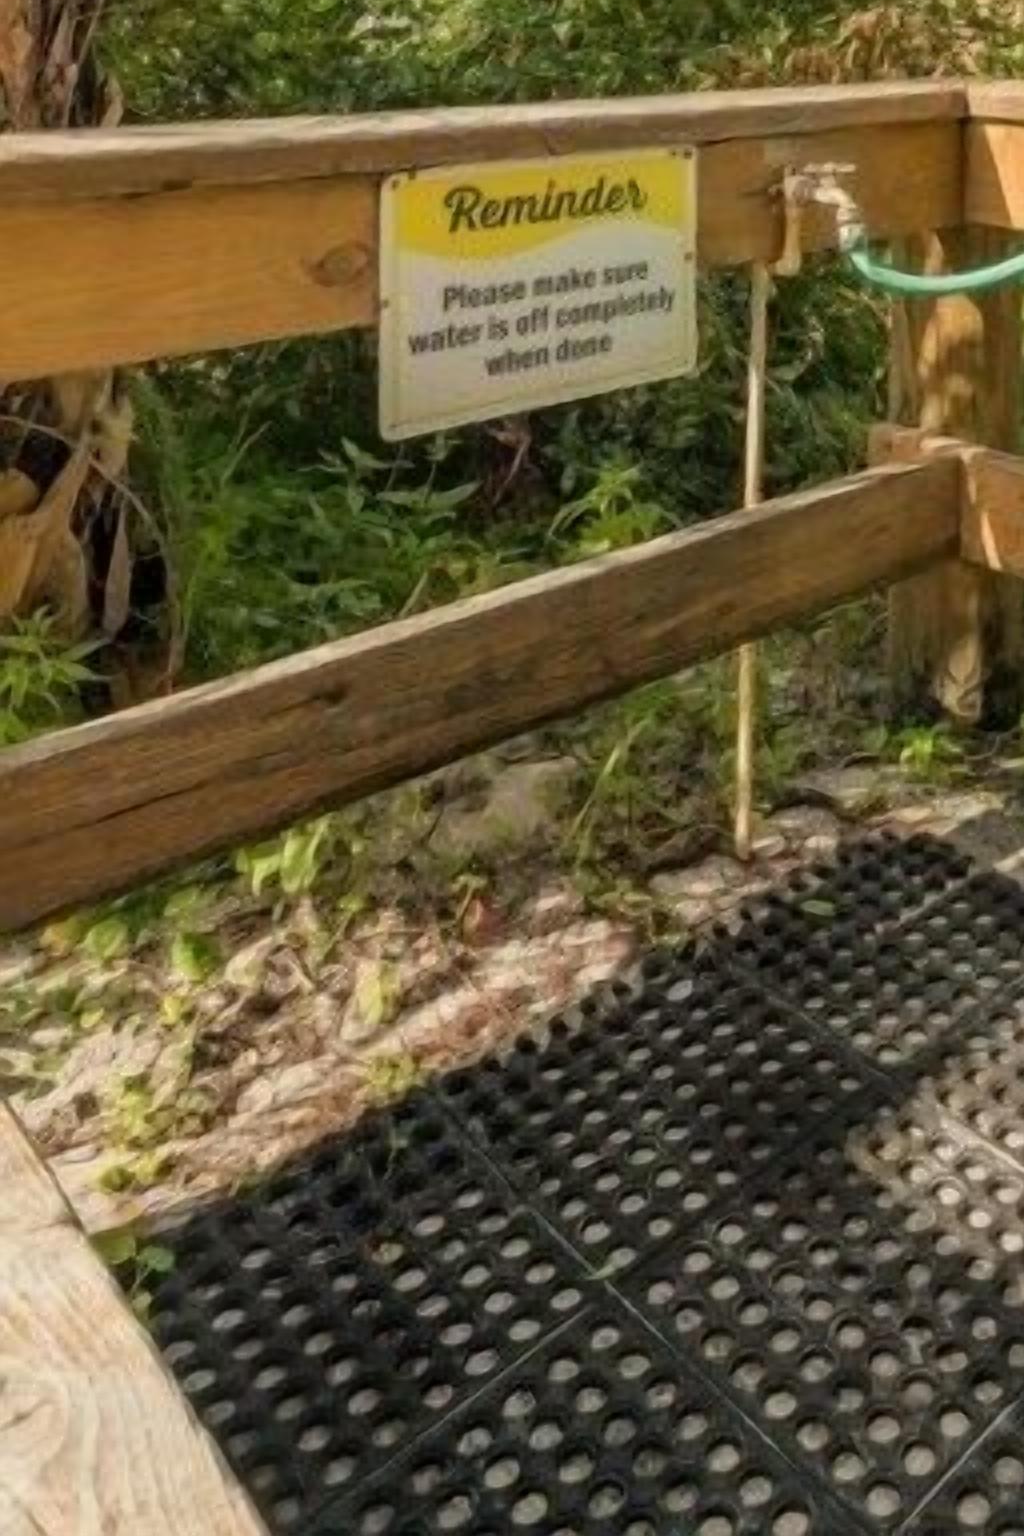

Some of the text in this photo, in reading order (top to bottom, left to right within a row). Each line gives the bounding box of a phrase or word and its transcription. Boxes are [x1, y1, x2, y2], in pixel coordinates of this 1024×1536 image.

[444, 175, 647, 232] Reminder
[444, 261, 648, 312] Please make sure
[408, 286, 674, 355] water is off completely
[484, 333, 612, 376] when done
